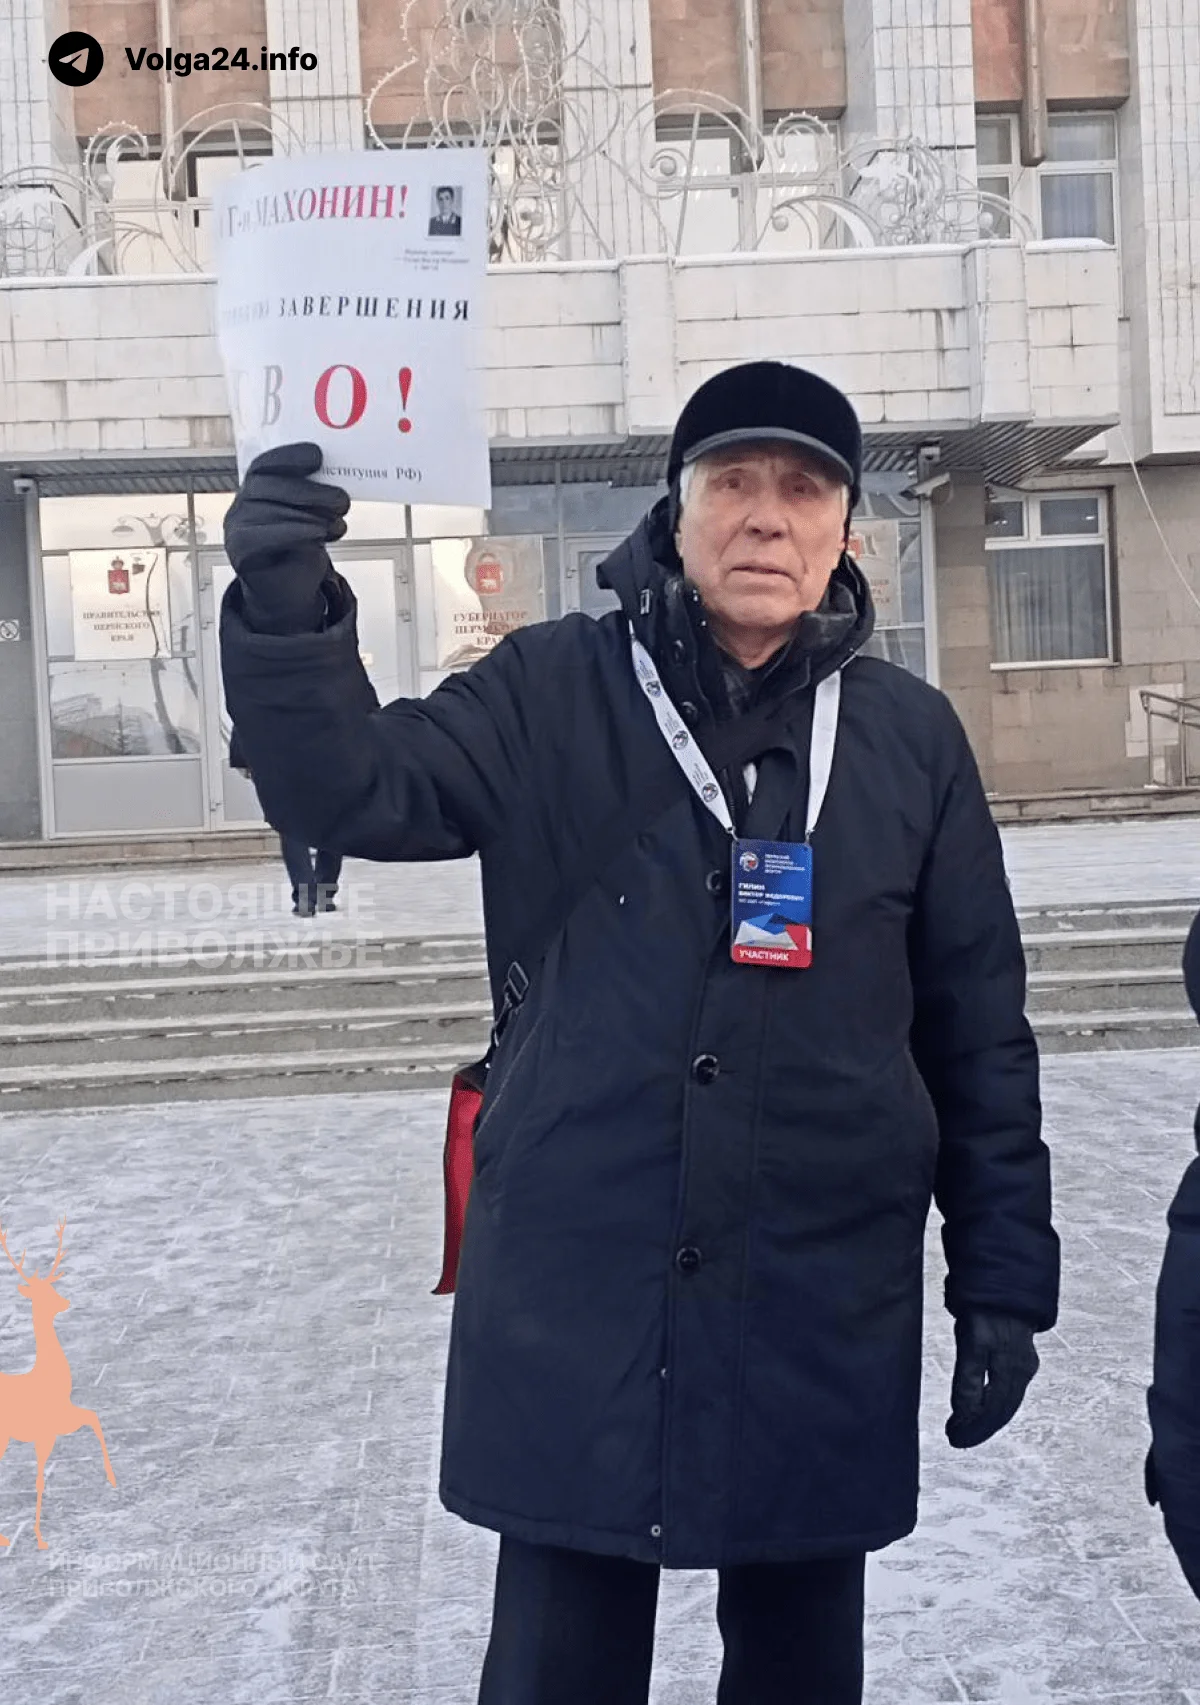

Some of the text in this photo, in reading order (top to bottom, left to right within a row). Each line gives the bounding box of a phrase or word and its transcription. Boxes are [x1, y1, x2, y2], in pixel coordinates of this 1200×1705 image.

[254, 184, 408, 227] МАХОНИН!
[279, 296, 469, 321] ЗАВЕРШЕНИЯ
[739, 949, 789, 961] УЧАСТНИК
